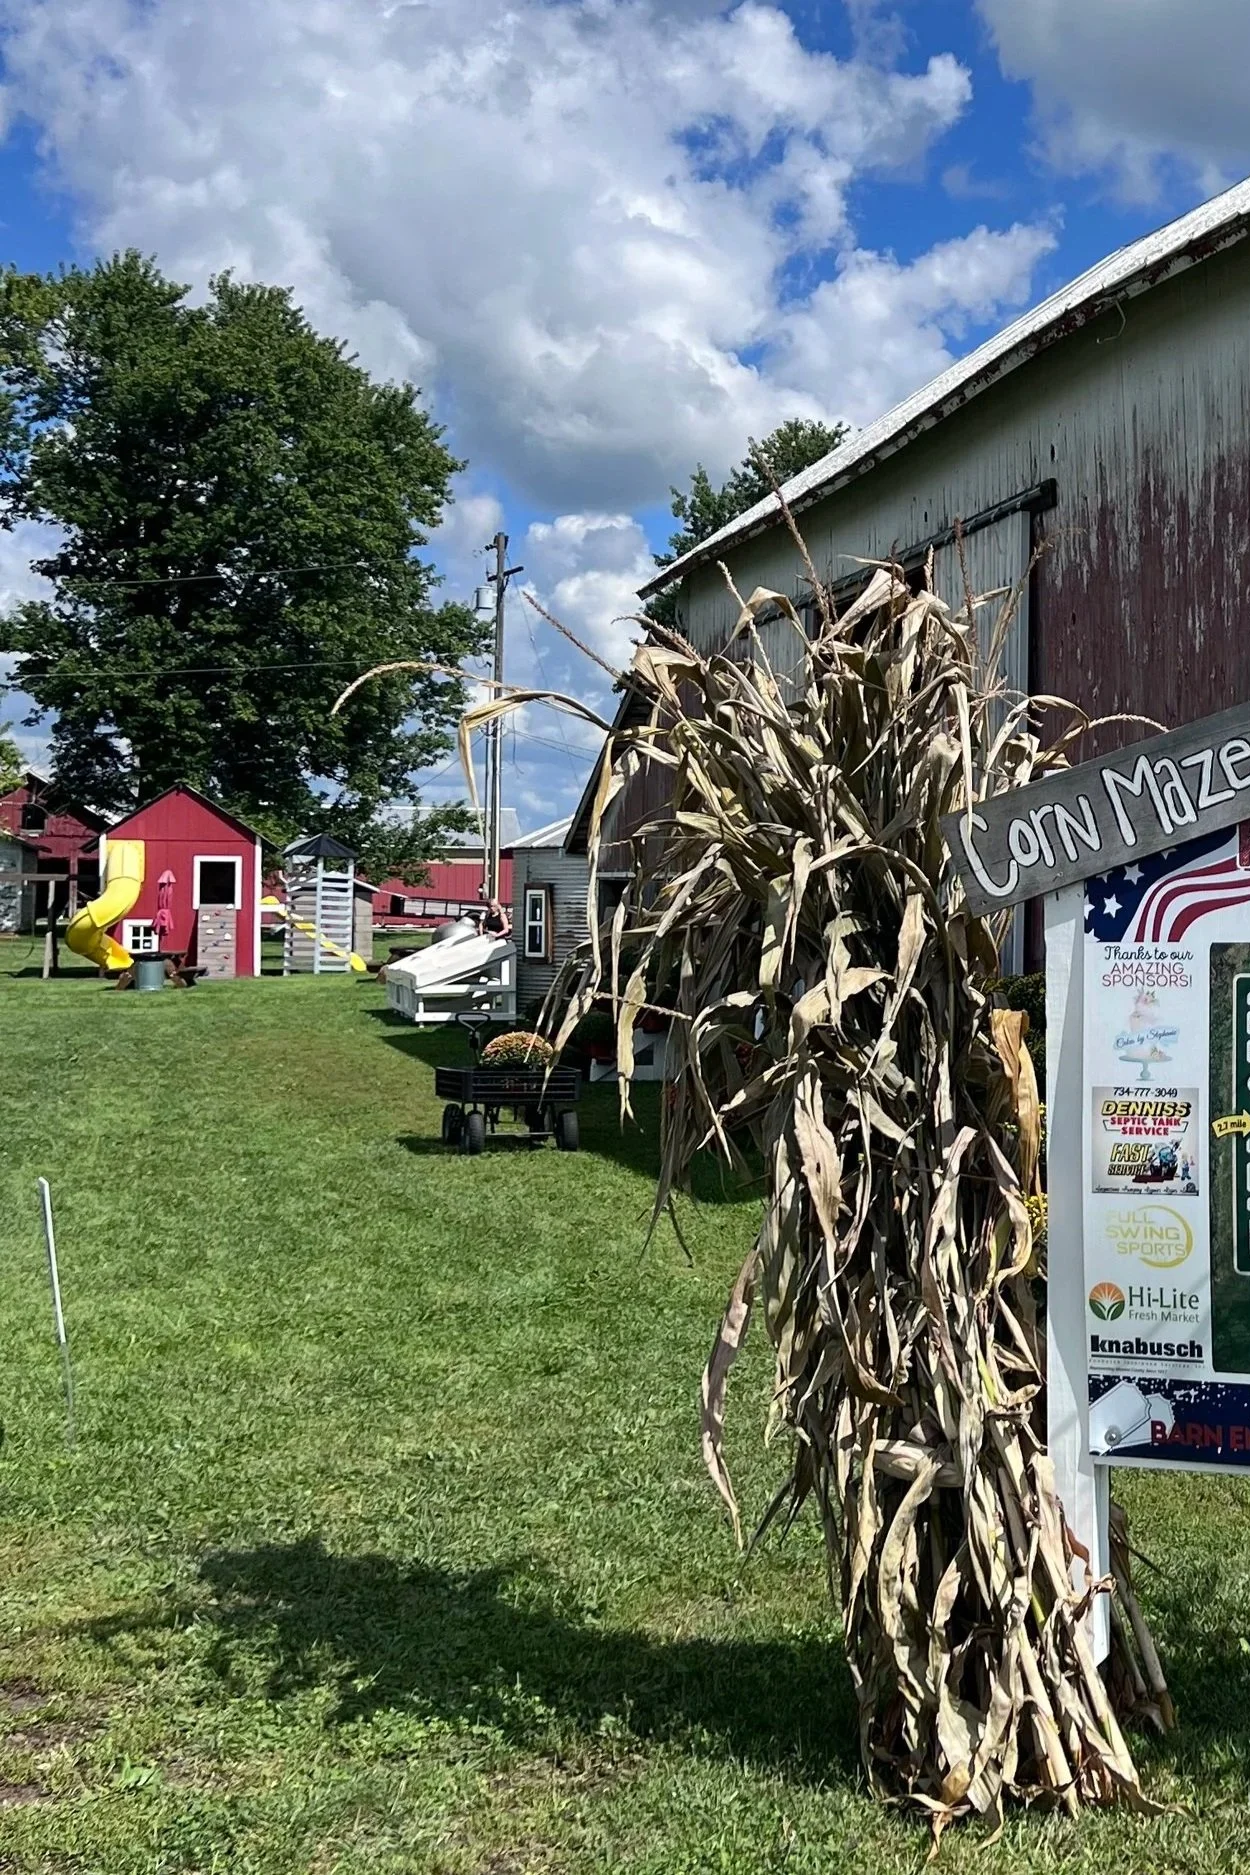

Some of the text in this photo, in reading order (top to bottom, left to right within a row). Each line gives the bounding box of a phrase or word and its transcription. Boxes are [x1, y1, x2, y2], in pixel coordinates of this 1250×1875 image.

[959, 794, 1101, 897] Corn
[1104, 945, 1194, 961] Thanks to our
[1110, 962, 1185, 975] AMAZING
[1102, 974, 1193, 988] SPONSORS!
[1113, 1086, 1178, 1098] 734-777-3049
[1110, 1116, 1181, 1127] SEPTIC TANK
[1229, 1118, 1247, 1129] mile
[1121, 1126, 1170, 1136] SERVICE
[1109, 1142, 1152, 1163] FAST
[1106, 1225, 1181, 1241] SWING
[1116, 1241, 1187, 1257] SPORTS
[1128, 1285, 1200, 1310] Hi-Lite
[1128, 1309, 1200, 1324] Fresh Market
[1151, 1419, 1223, 1448] BARN
